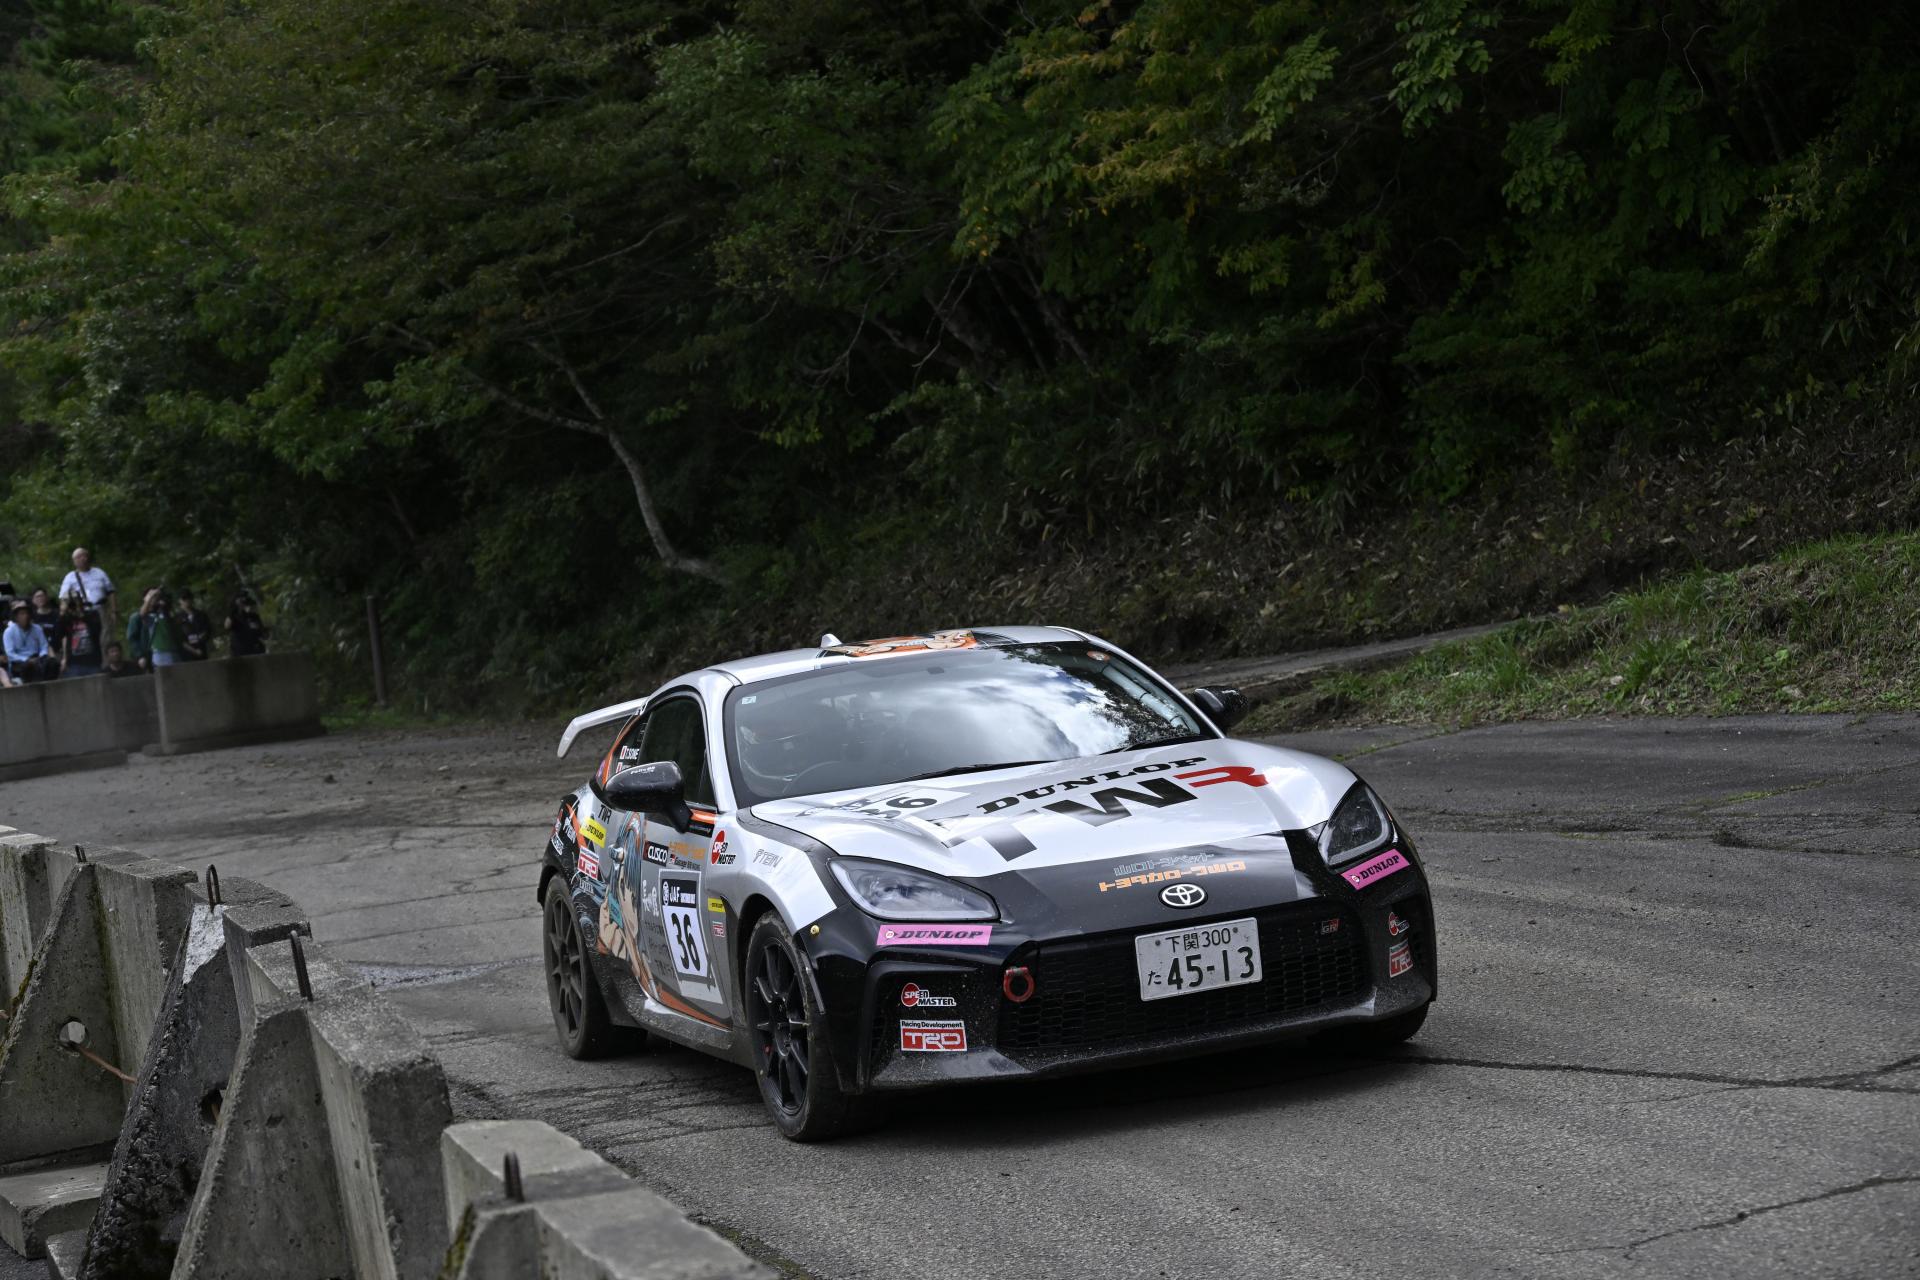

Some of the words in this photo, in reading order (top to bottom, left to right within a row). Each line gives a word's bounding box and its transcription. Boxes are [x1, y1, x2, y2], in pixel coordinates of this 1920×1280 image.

[977, 755, 1207, 814] DUNLOP
[940, 766, 1268, 862] TWR
[586, 824, 605, 841] DUNLOP
[647, 845, 669, 863] CUSCO
[719, 853, 737, 865] MASTER
[759, 851, 783, 868] TEIN
[1113, 852, 1215, 877] 山口トヨペット
[1361, 853, 1401, 880] DUNLOP
[1098, 861, 1247, 893] トヨタカローラ山口
[669, 885, 680, 903] JAF
[670, 912, 701, 972] 36
[897, 930, 984, 939] DUNLOP
[1147, 970, 1162, 986] た
[1167, 946, 1255, 990] 45-13
[904, 990, 929, 999] SPEED
[918, 998, 955, 1006] MASTER
[904, 1032, 961, 1050] TRD
